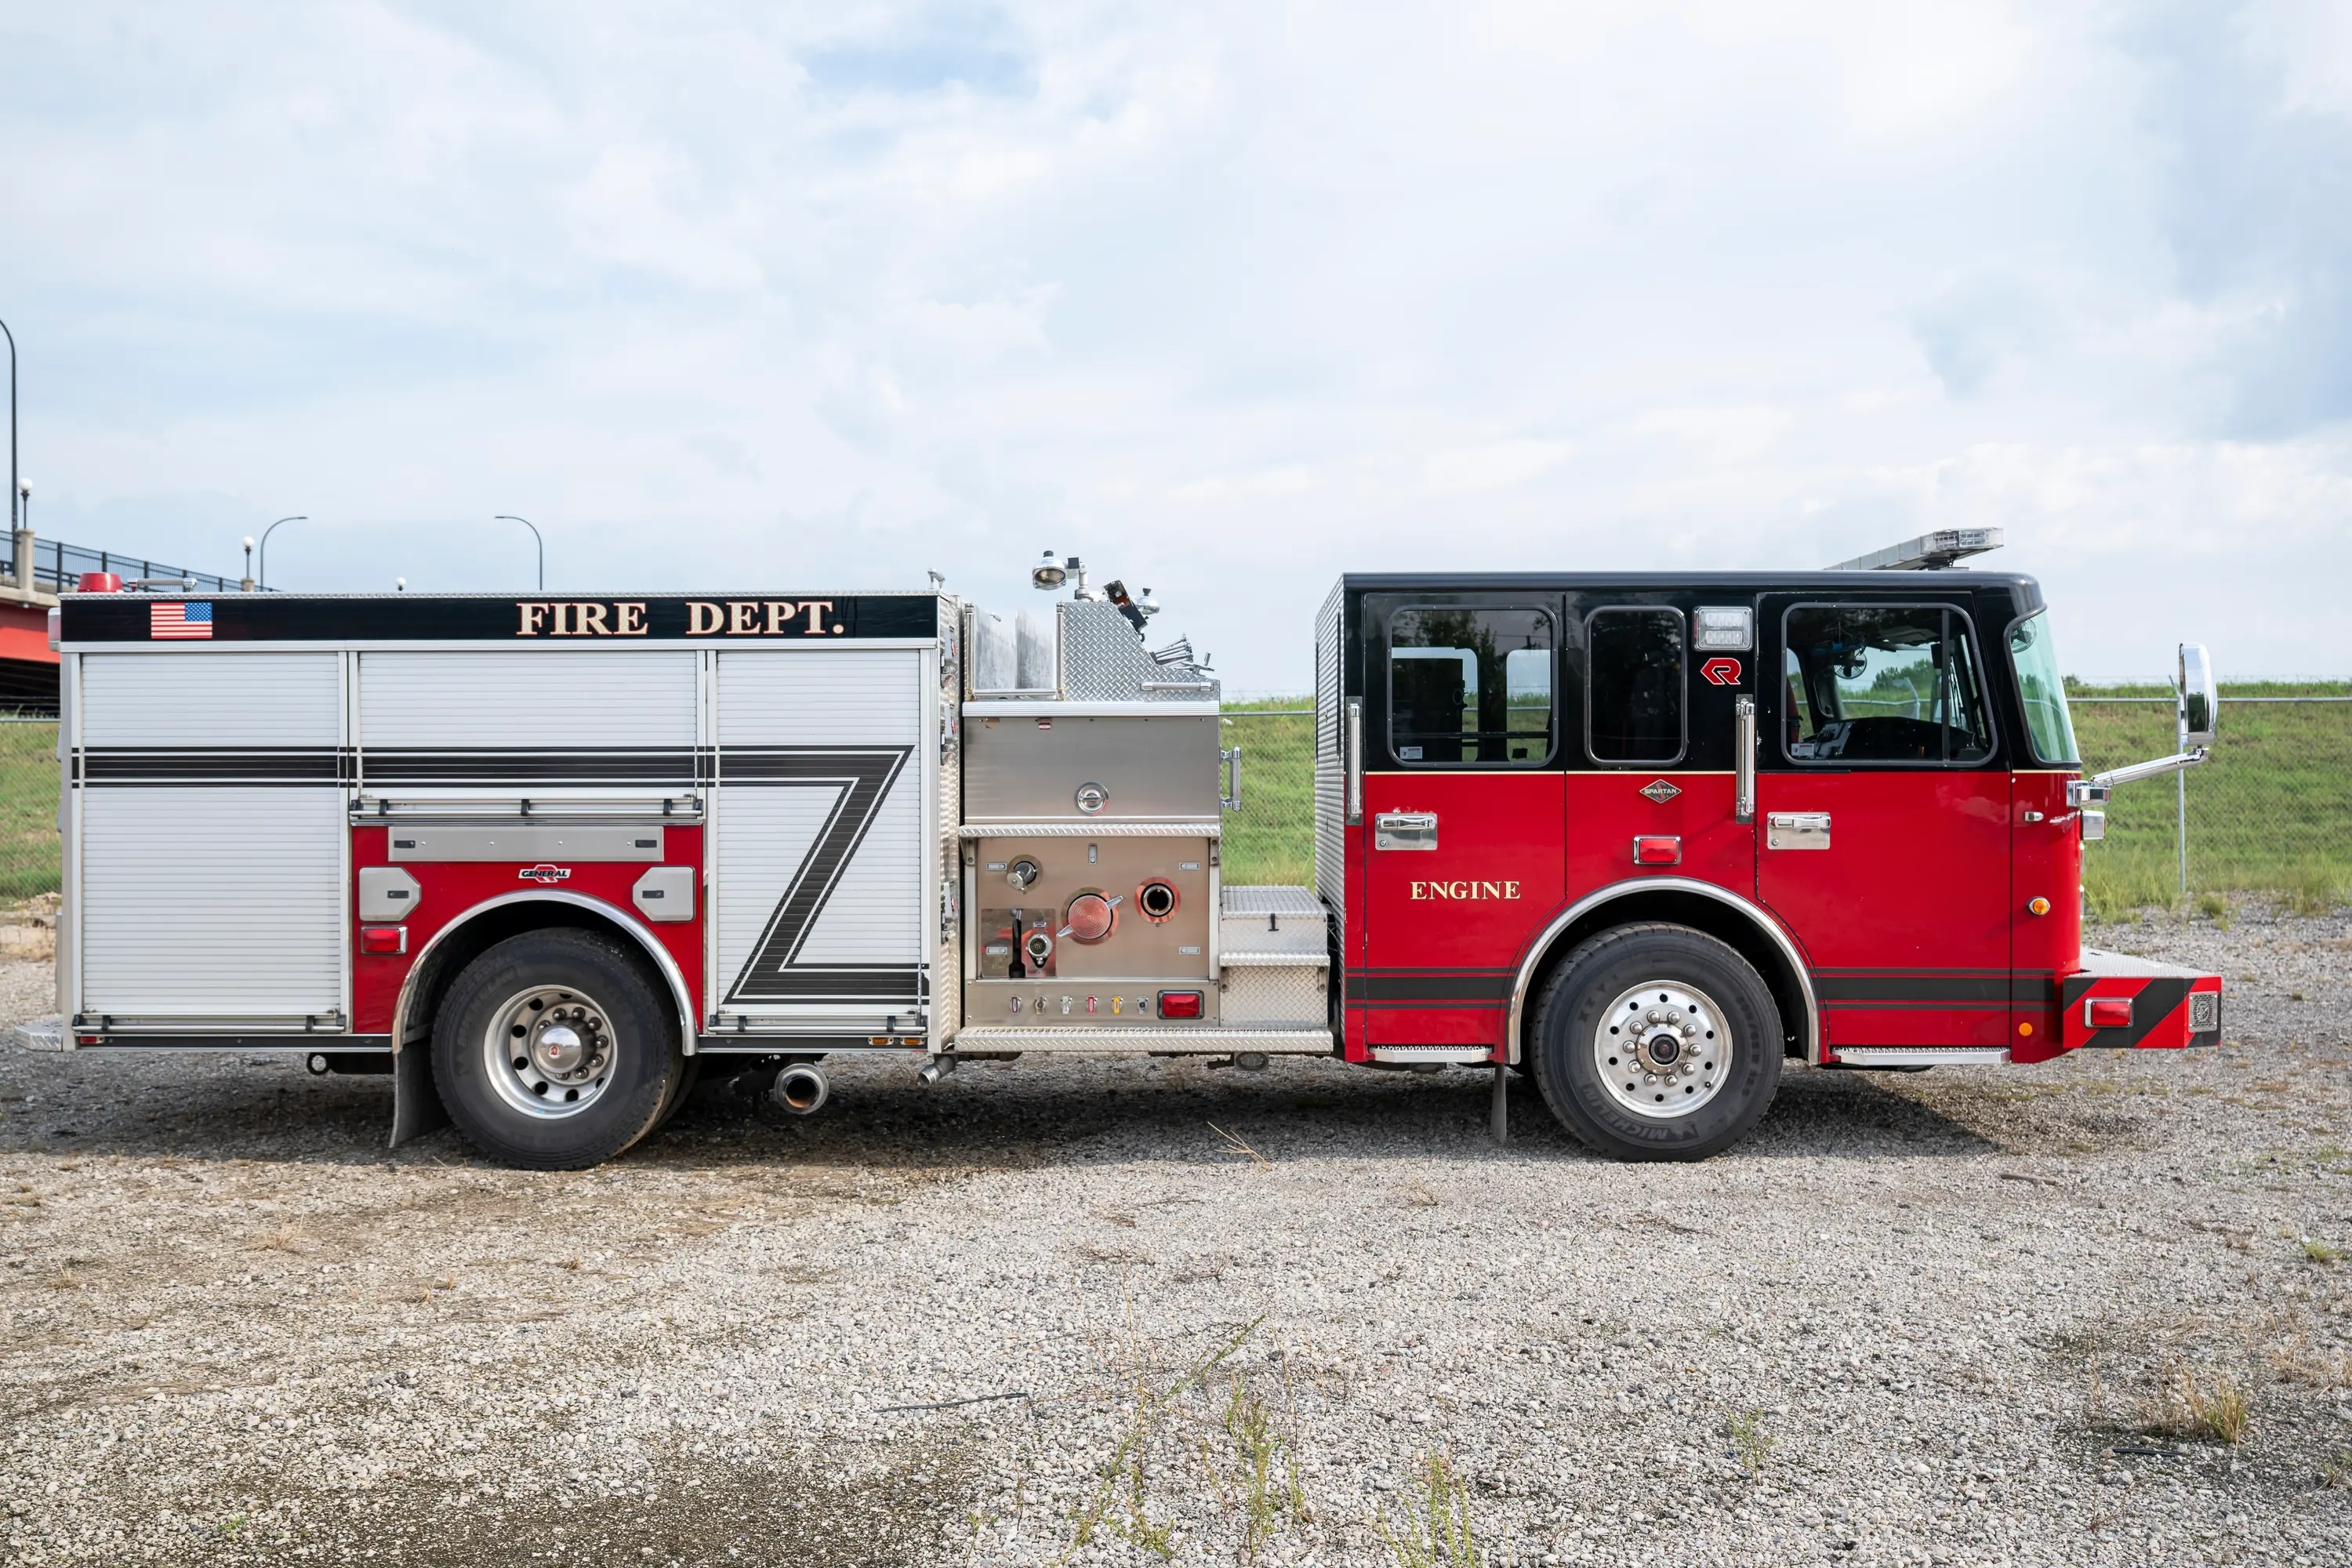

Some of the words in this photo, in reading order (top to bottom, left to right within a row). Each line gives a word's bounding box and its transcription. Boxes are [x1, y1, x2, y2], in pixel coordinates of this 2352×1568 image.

[516, 602, 649, 635] FIRE
[685, 601, 844, 635] DEPT.
[1410, 880, 1521, 900] ENGINE
[1581, 1086, 1669, 1141] MICHELIN
